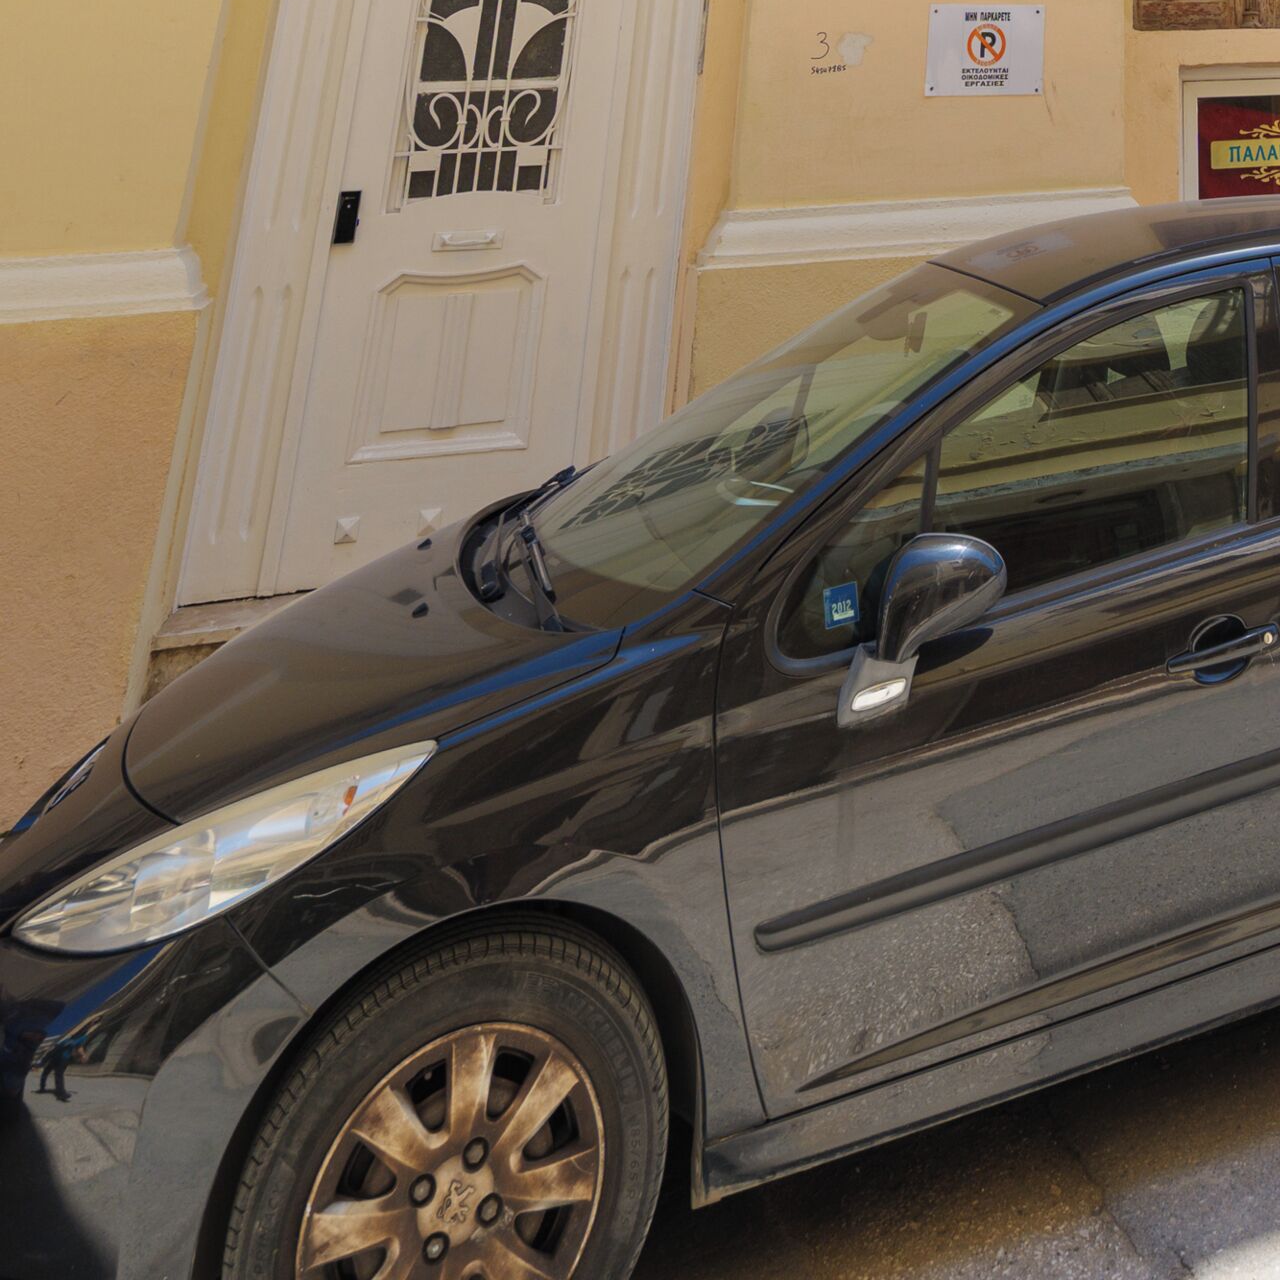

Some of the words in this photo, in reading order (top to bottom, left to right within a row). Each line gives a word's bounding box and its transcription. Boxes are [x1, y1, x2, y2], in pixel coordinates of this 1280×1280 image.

[980, 11, 1011, 21] ΠΑΡΚΑΡΕΤΕ
[832, 599, 852, 615] 2012
[562, 992, 640, 1098] MICHELIN
